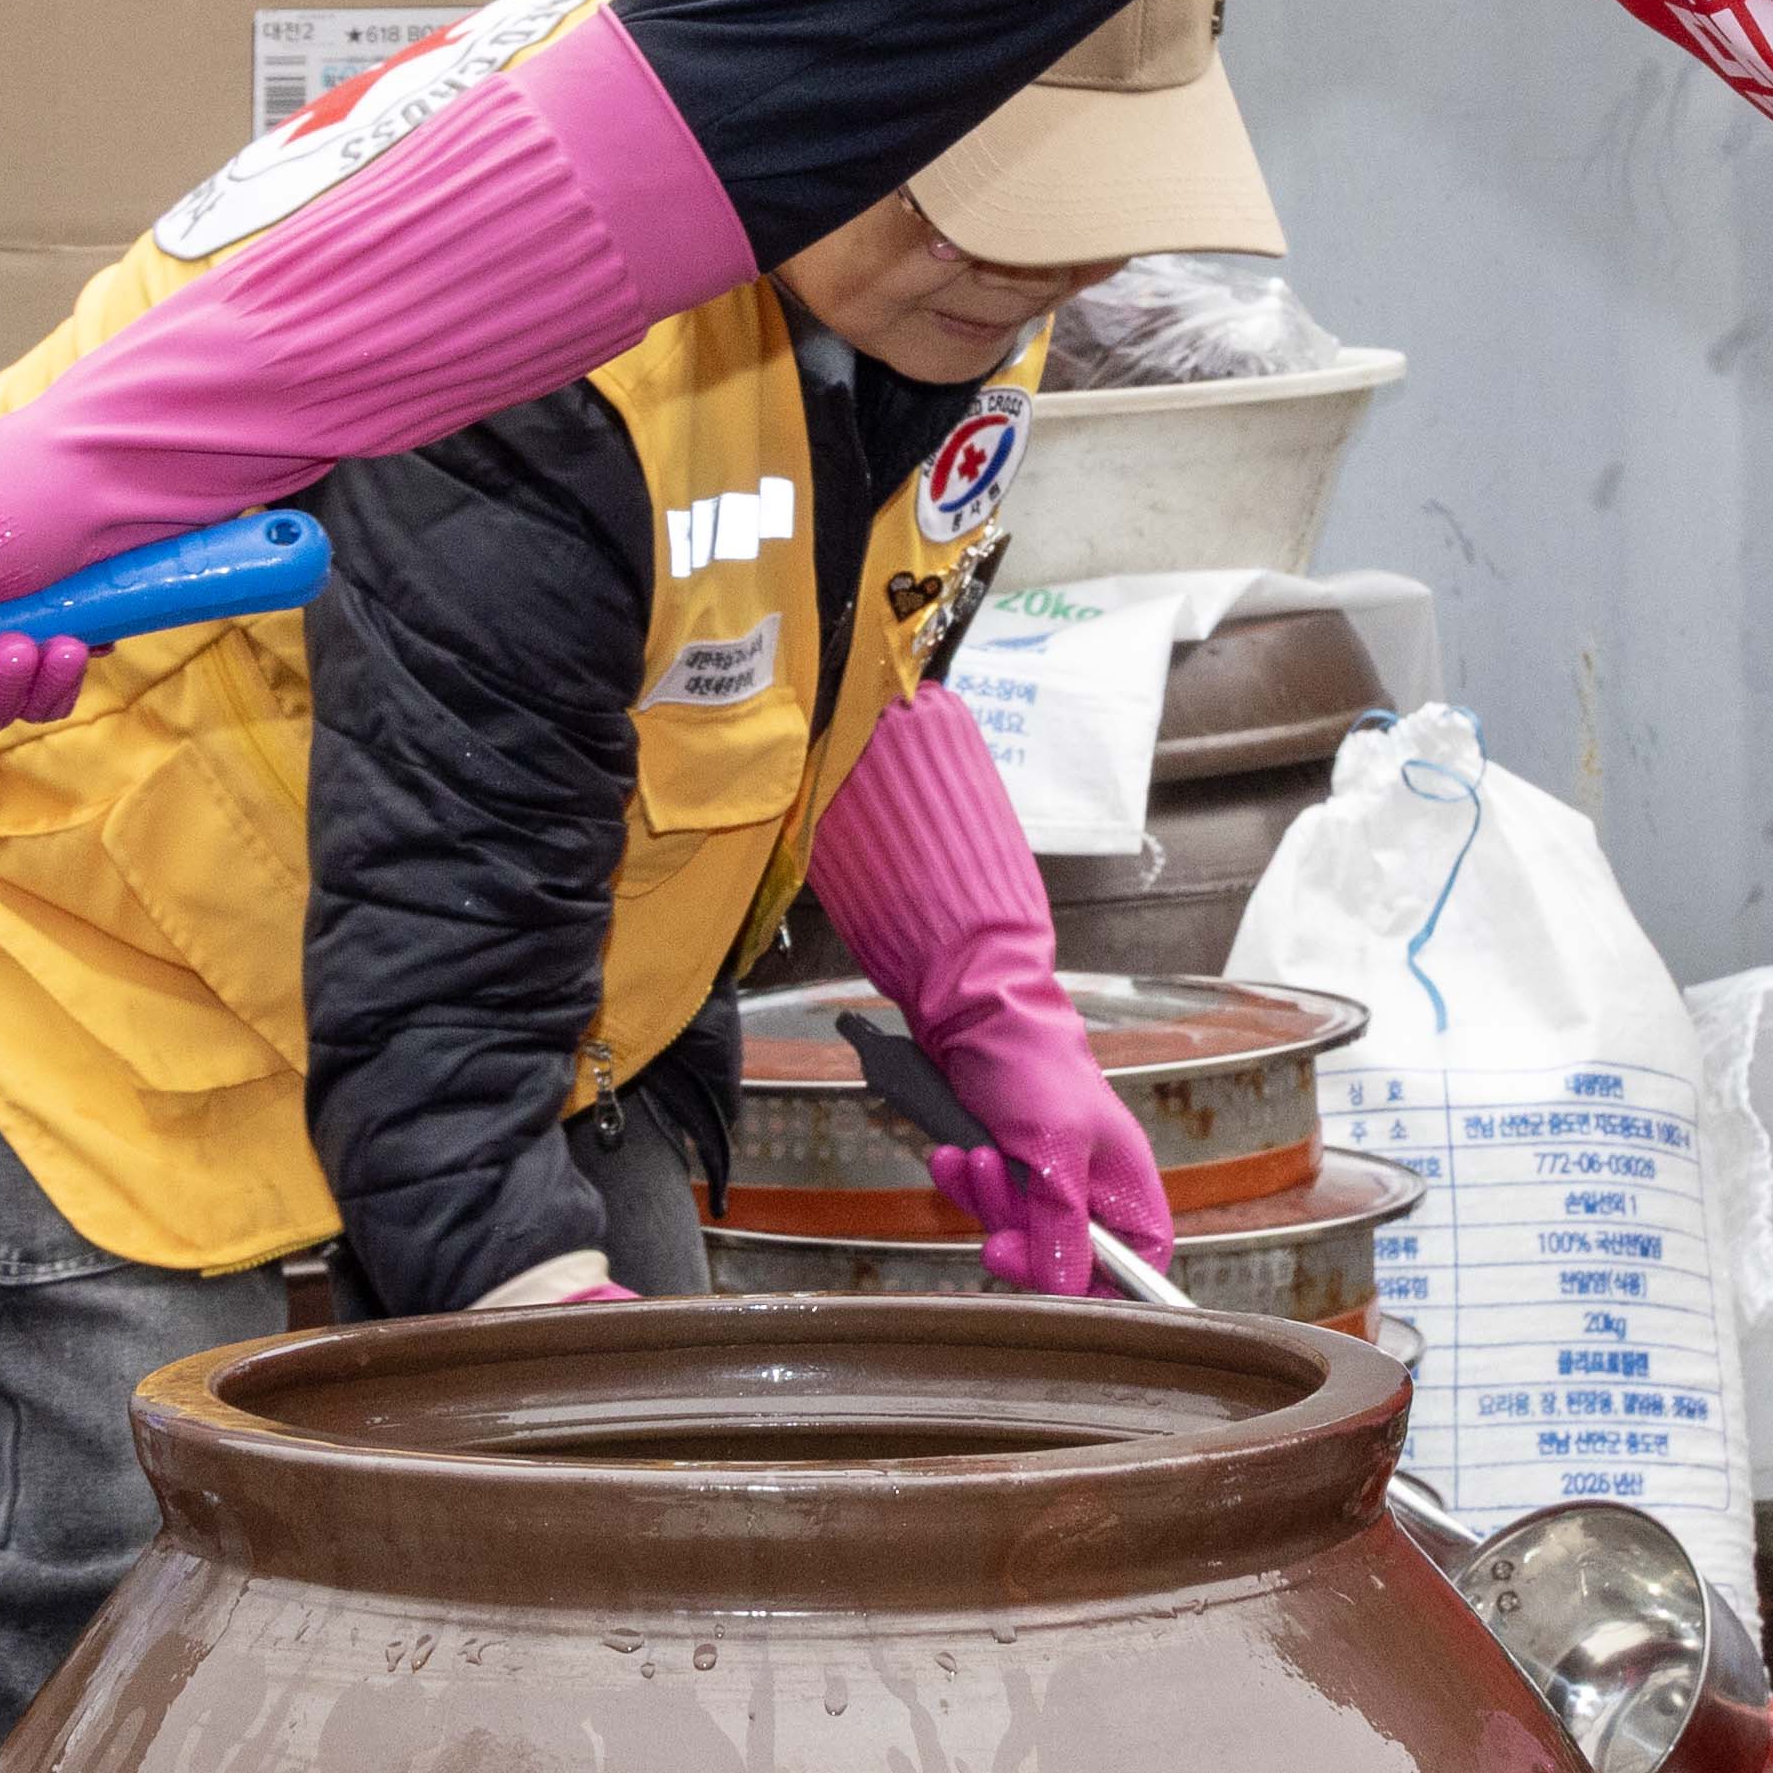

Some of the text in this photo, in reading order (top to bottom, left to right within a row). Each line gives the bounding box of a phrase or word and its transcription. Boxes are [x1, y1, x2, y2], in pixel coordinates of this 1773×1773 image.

[262, 21, 315, 44] 대전2
[366, 25, 401, 44] 618
[987, 393, 1024, 418] CROSS
[1538, 1232, 1593, 1255] 100%
[1582, 1310, 1628, 1341] 20kg
